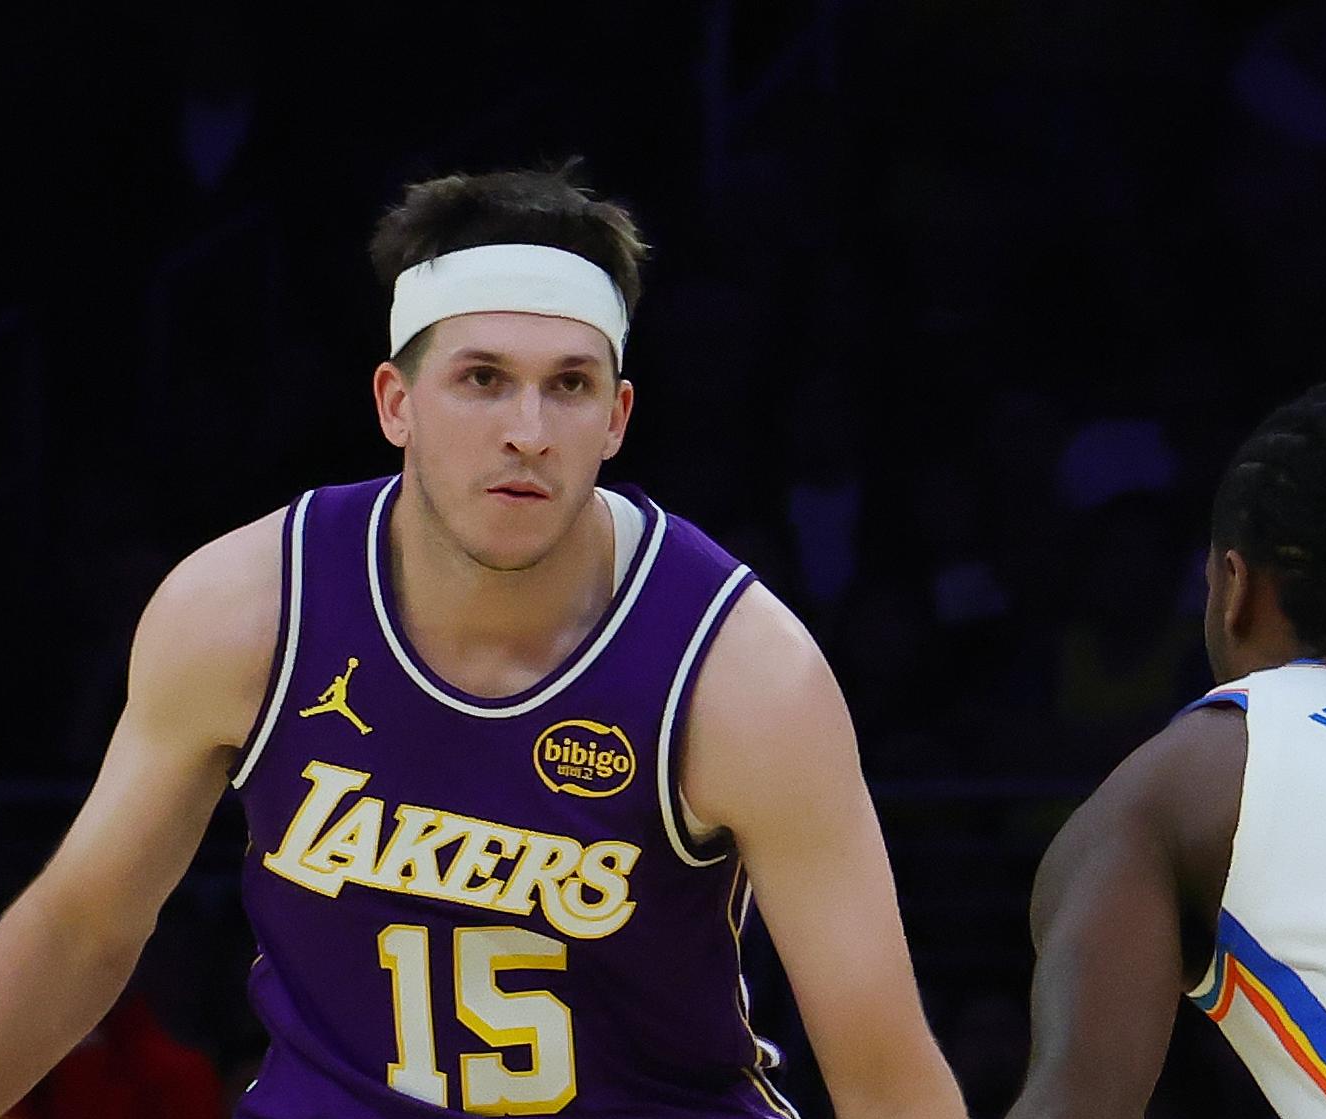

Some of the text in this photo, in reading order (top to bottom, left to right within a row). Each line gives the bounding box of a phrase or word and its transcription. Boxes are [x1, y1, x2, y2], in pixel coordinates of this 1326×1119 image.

[544, 737, 630, 778] bibigo
[263, 758, 642, 939] LAKERS
[376, 923, 578, 1118] 15
